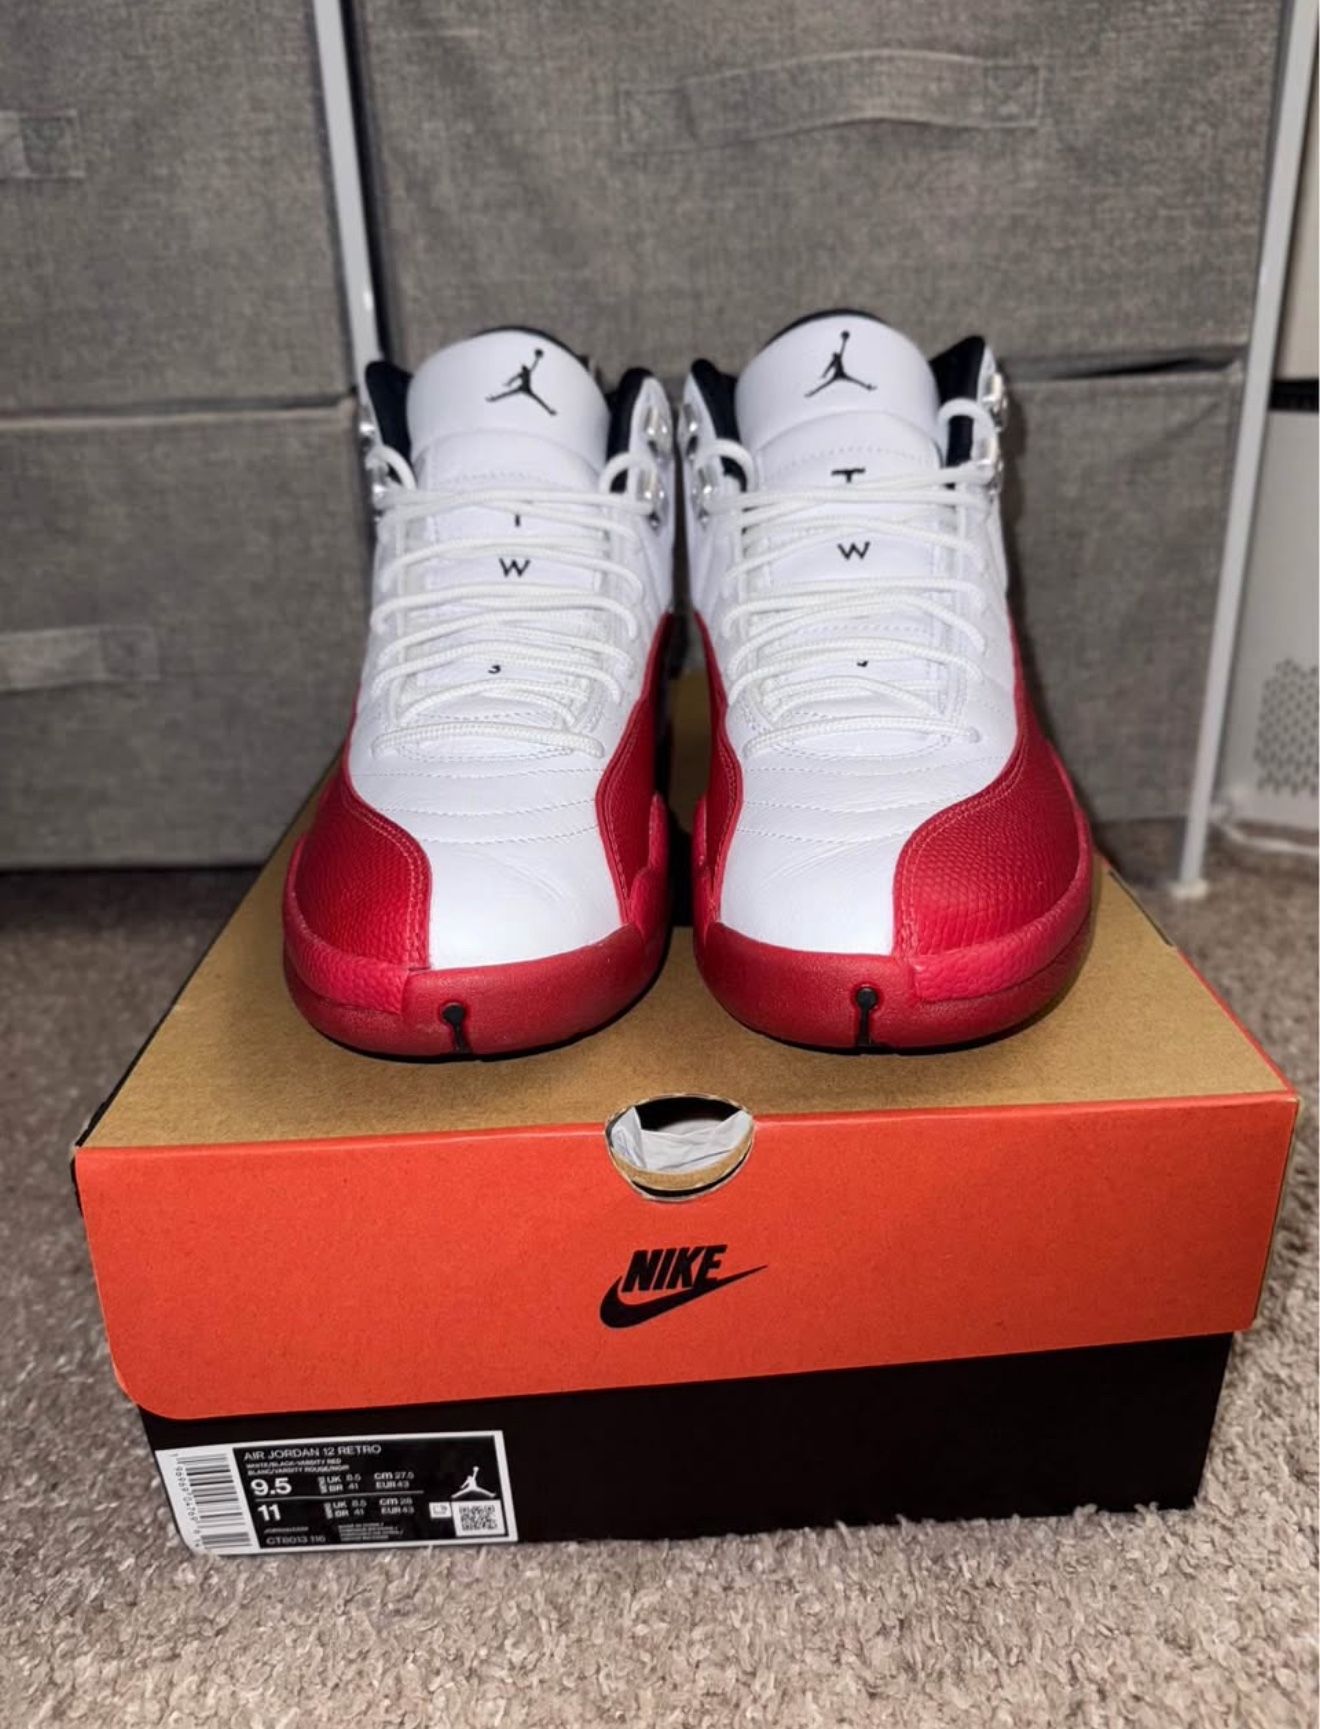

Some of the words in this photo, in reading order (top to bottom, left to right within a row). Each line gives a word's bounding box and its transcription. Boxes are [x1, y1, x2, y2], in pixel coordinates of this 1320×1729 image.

[837, 541, 870, 560] W
[499, 557, 531, 578] W
[621, 1244, 728, 1292] NIKE
[244, 1450, 264, 1461] AIR
[268, 1447, 319, 1459] JORDAN
[323, 1447, 335, 1456] 12
[338, 1444, 382, 1455] RETRO
[326, 1476, 341, 1484] UK
[374, 1472, 393, 1480] cm
[376, 1480, 396, 1488] EUR
[250, 1477, 292, 1496] 9.5
[257, 1504, 281, 1521] 11
[333, 1500, 347, 1508] UK
